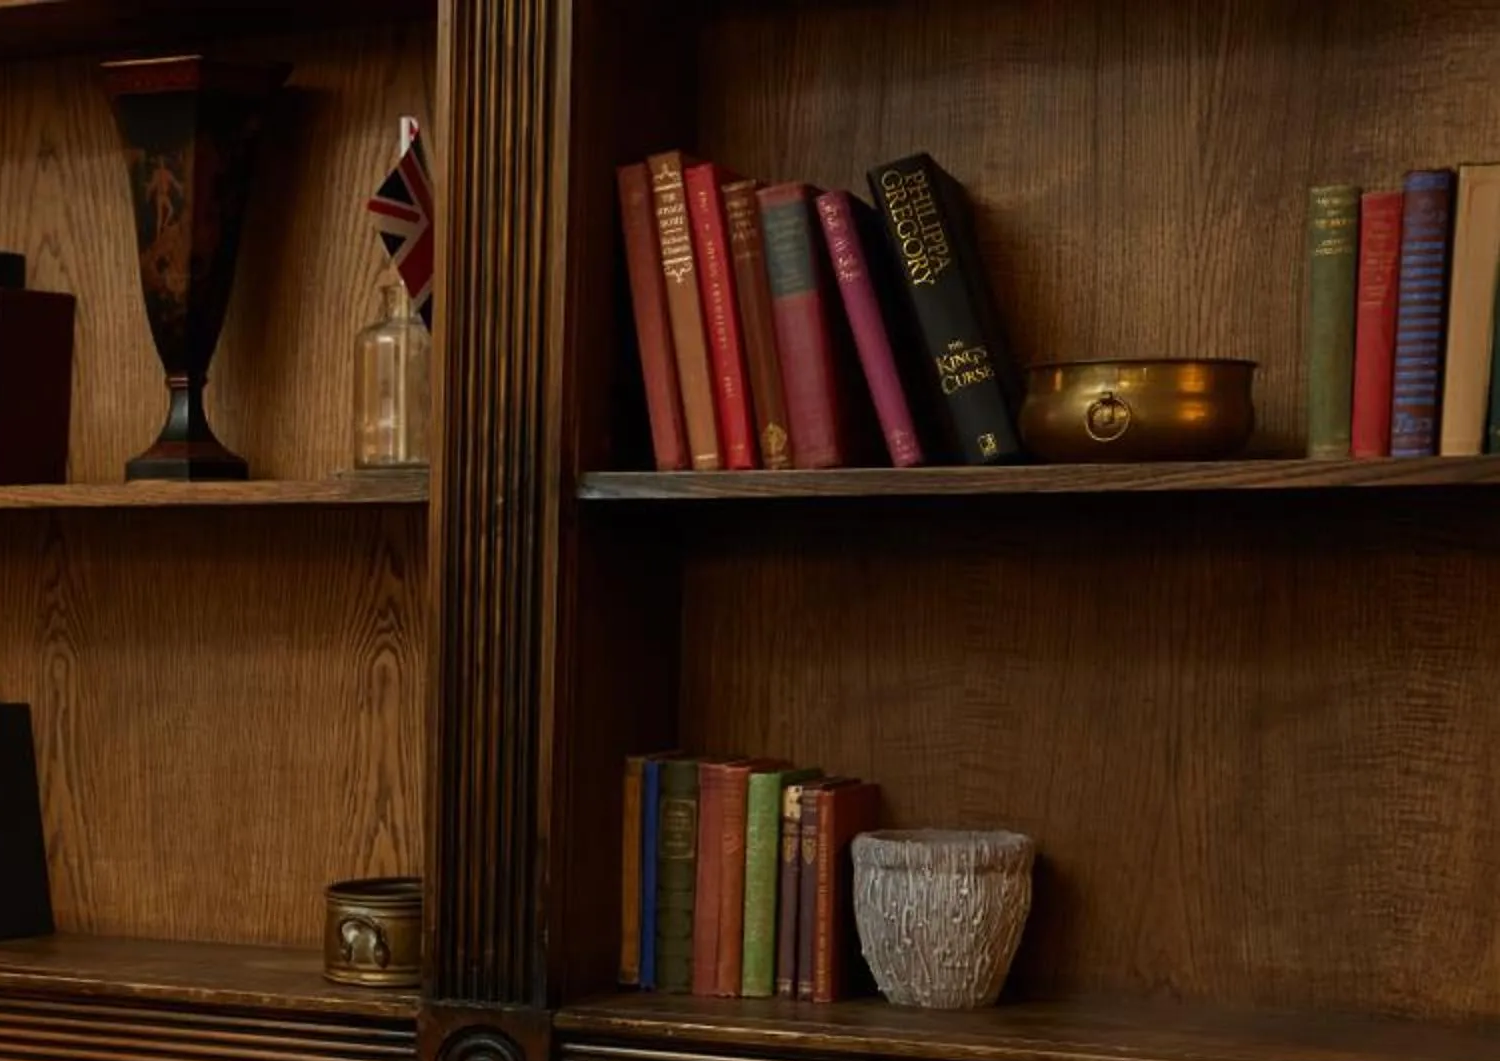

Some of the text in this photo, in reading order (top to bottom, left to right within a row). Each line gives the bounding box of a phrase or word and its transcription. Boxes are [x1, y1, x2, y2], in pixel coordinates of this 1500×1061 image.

[881, 169, 935, 287] GREGORY
[905, 168, 952, 273] PHILIPPA
[941, 367, 995, 395] CURSE
